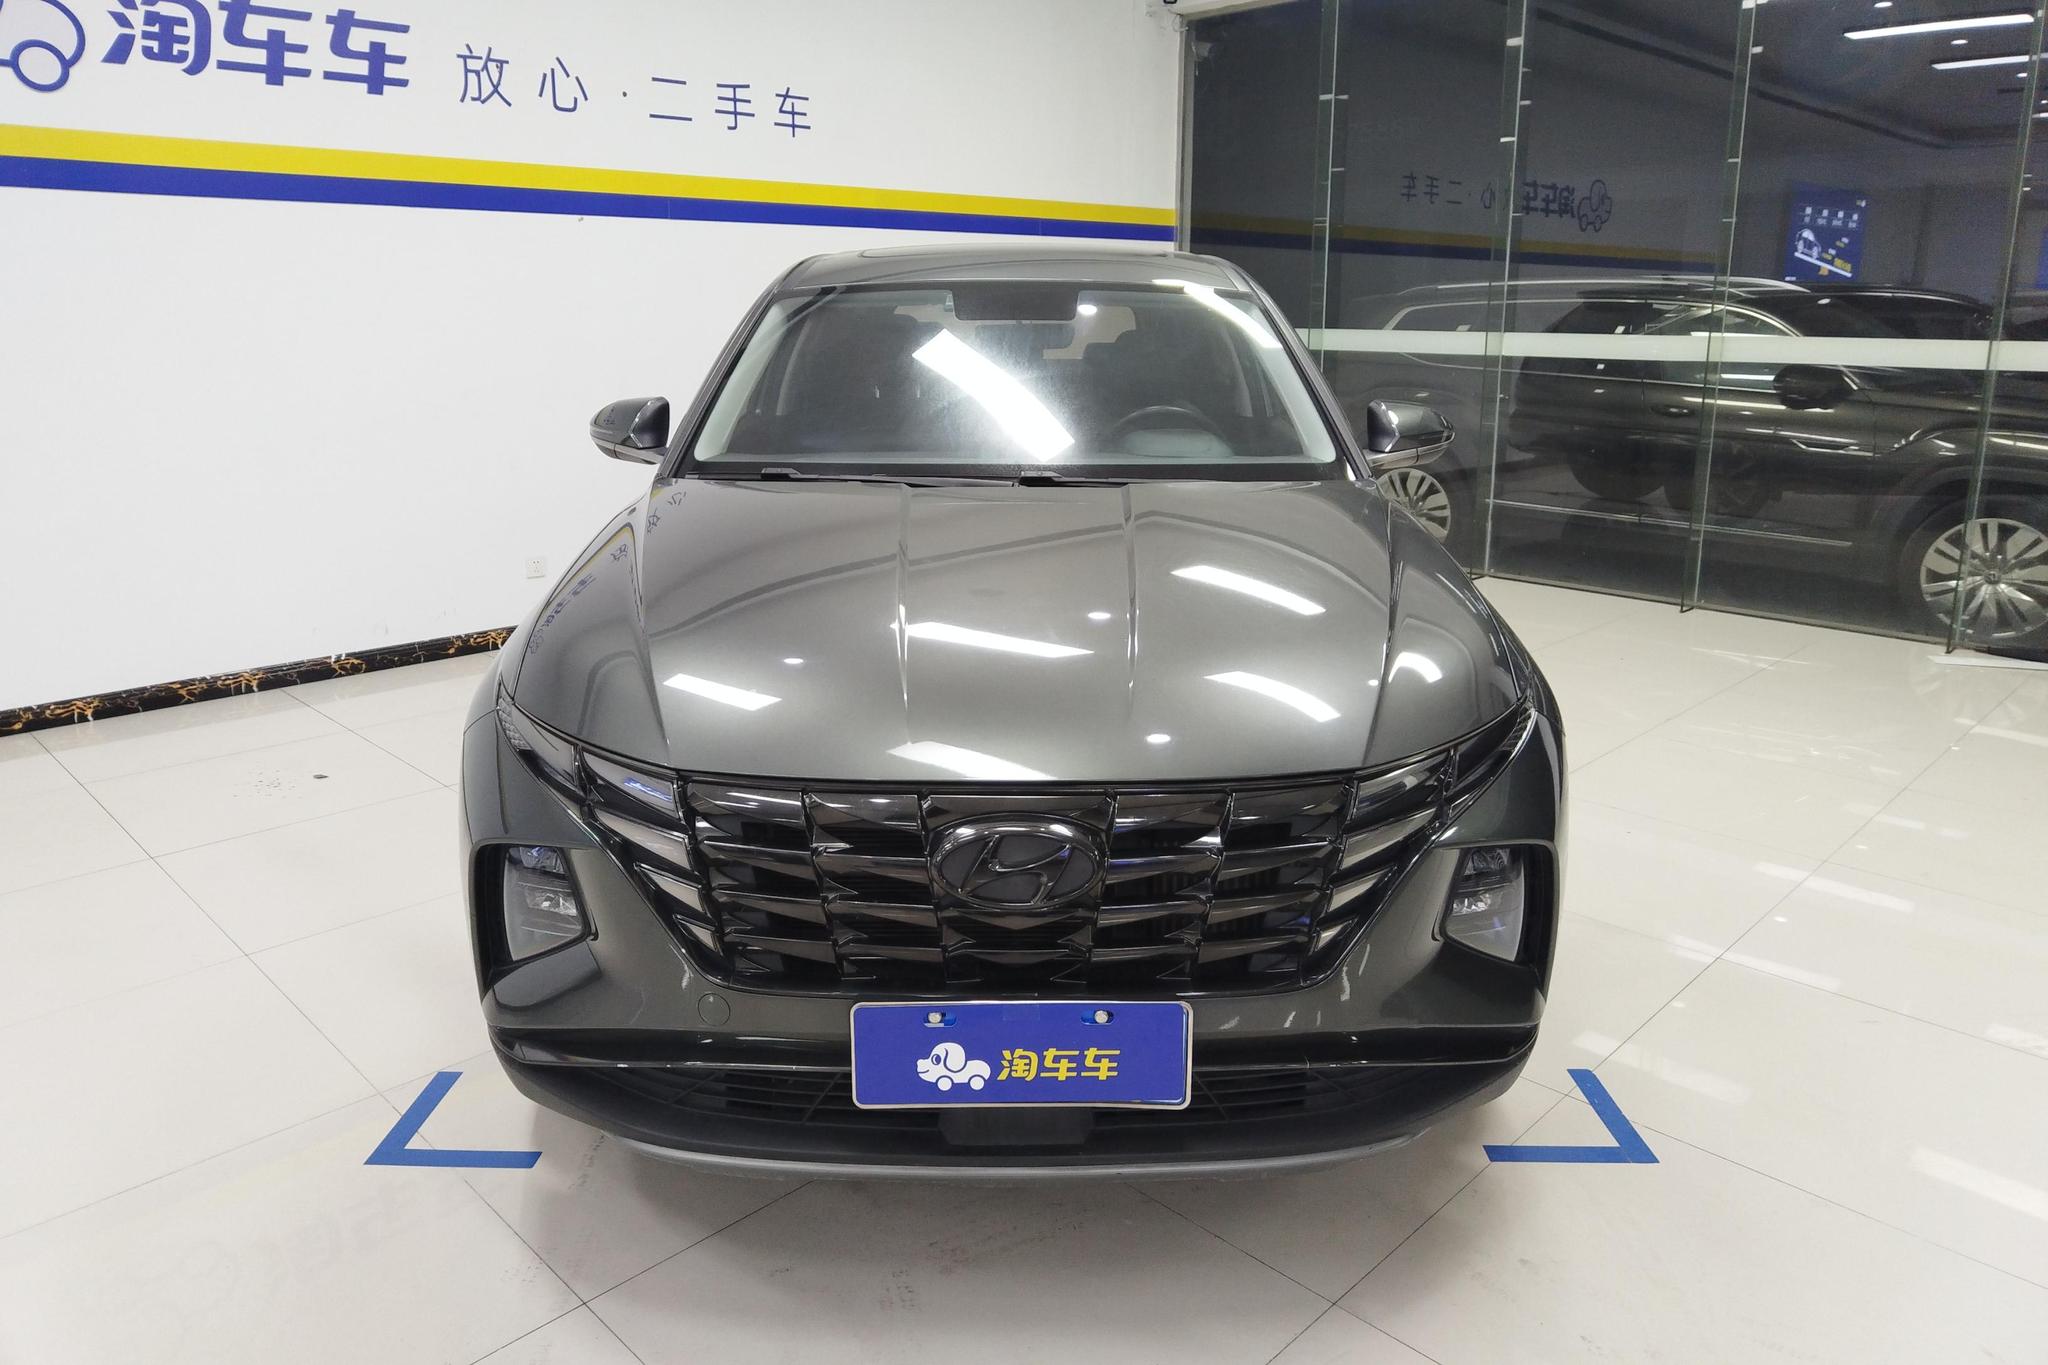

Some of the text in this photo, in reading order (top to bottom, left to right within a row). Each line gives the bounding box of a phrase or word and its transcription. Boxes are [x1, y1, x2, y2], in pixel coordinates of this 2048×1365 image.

[102, 0, 410, 96] 淘车车
[997, 1047, 1121, 1081] 淘车车
